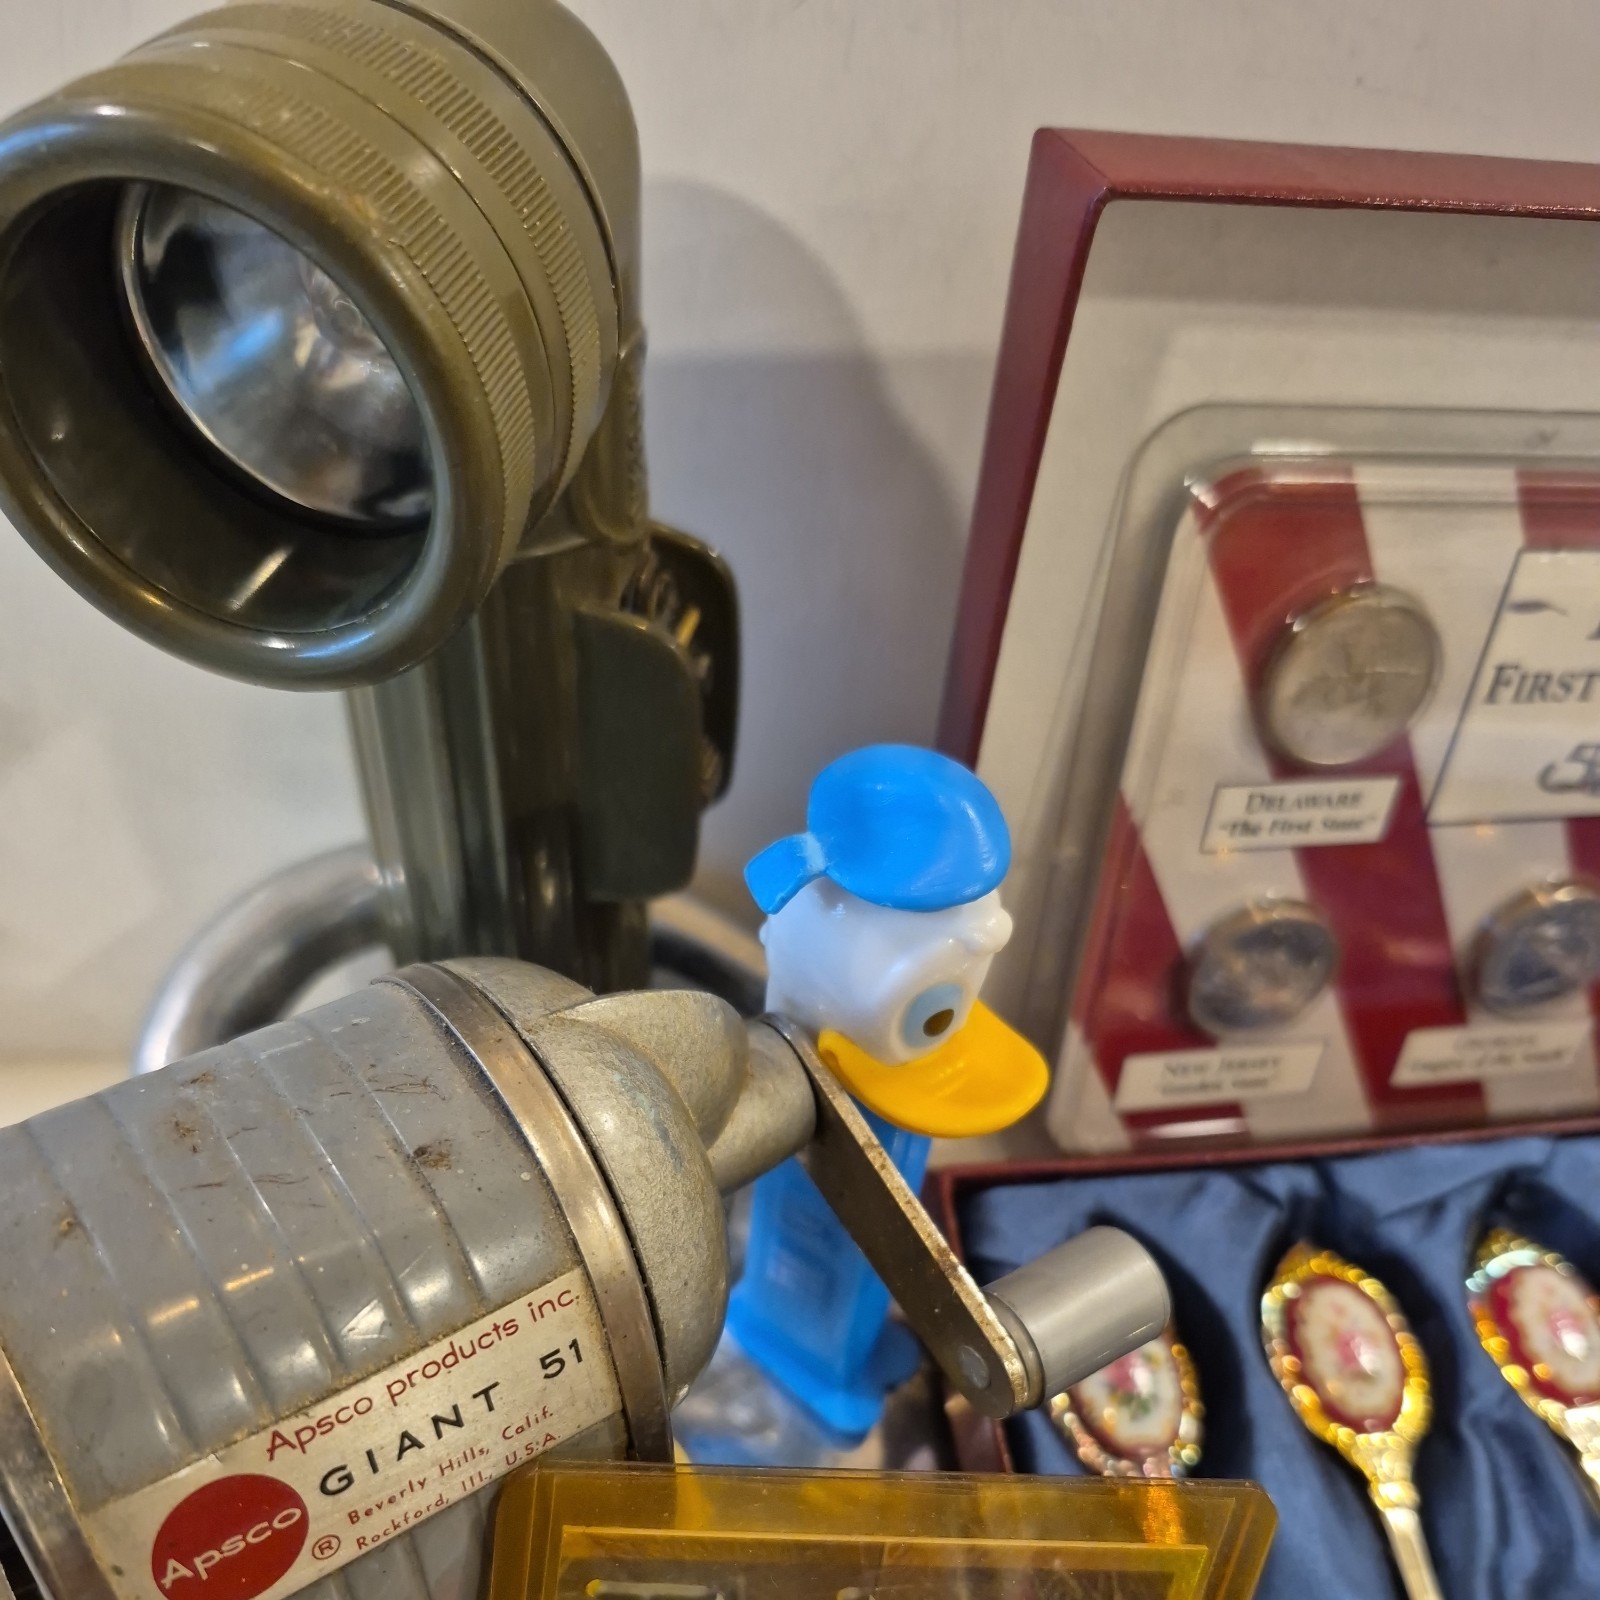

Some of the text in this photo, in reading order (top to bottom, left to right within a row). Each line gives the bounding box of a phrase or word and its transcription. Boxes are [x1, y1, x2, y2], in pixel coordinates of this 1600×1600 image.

[265, 1287, 582, 1461] Apsco products inc.
[318, 1337, 584, 1497] GIANT 51
[347, 1405, 554, 1525] Beverly Hills, Calif.
[356, 1493, 450, 1551] Rockford,
[160, 1506, 303, 1590] Apsco
